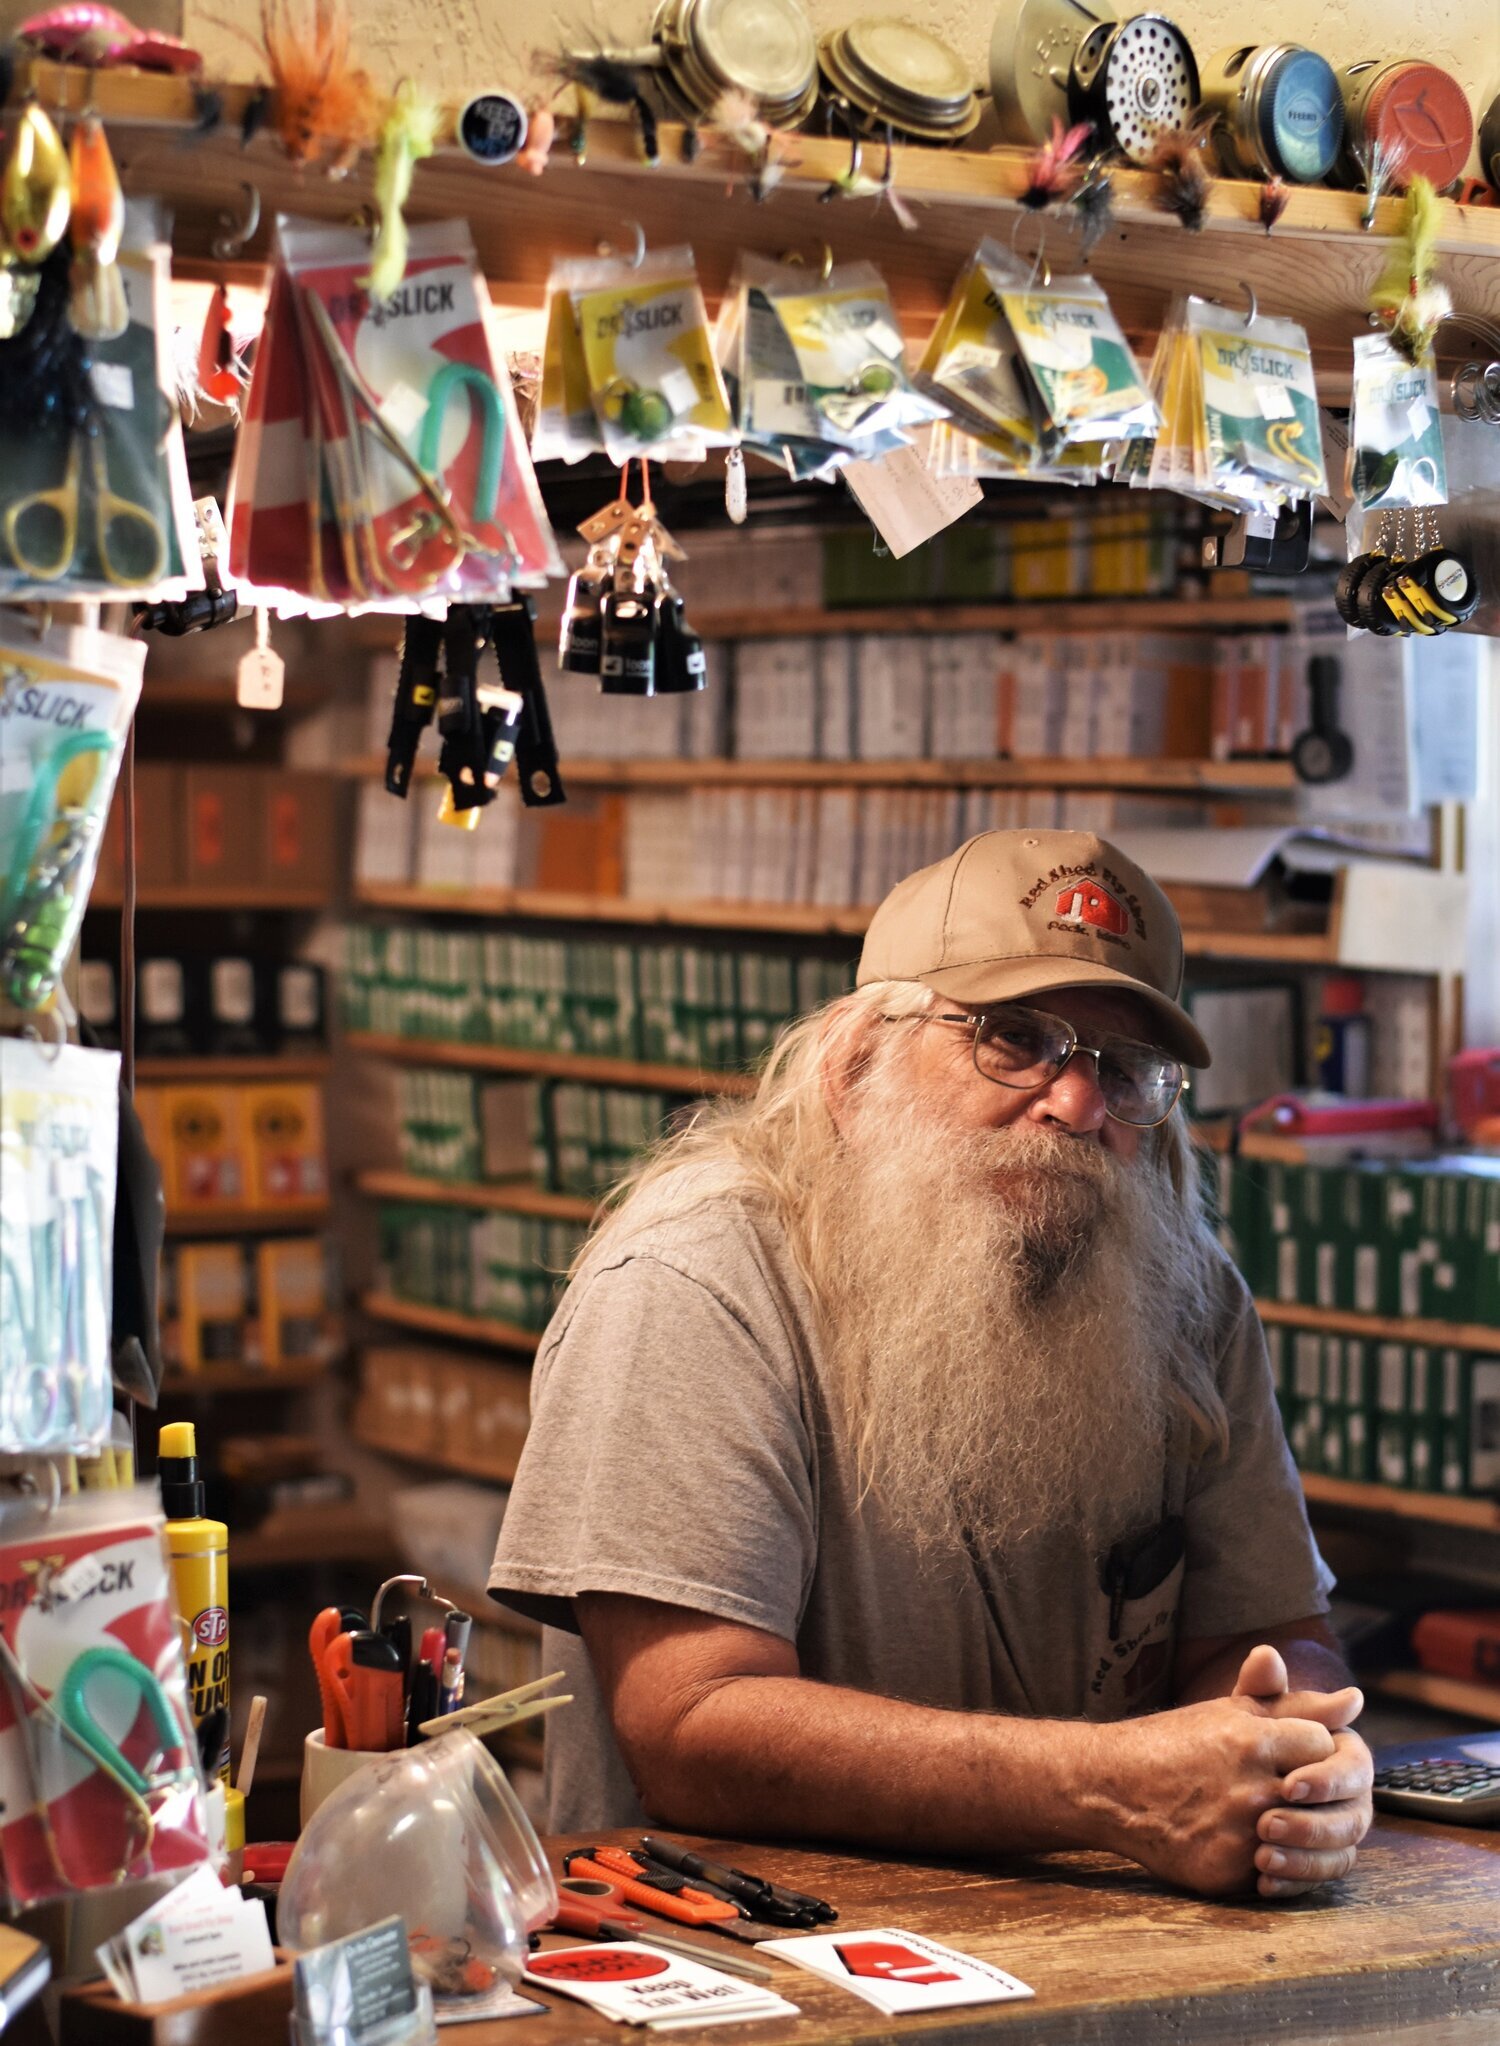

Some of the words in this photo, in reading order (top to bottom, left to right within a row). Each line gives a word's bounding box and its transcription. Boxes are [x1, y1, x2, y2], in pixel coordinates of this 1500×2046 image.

[388, 284, 455, 318] SLICK
[632, 304, 683, 332] SLICK
[1217, 348, 1240, 371] DR
[1250, 356, 1295, 380] SLICK
[1396, 378, 1427, 402] SLICK
[17, 687, 96, 731] SLICK
[1019, 878, 1050, 909] Red
[1049, 862, 1097, 883] Shed
[199, 1612, 227, 1640] STP
[1091, 1657, 1113, 1694] Red
[624, 1979, 694, 1995] Keep
